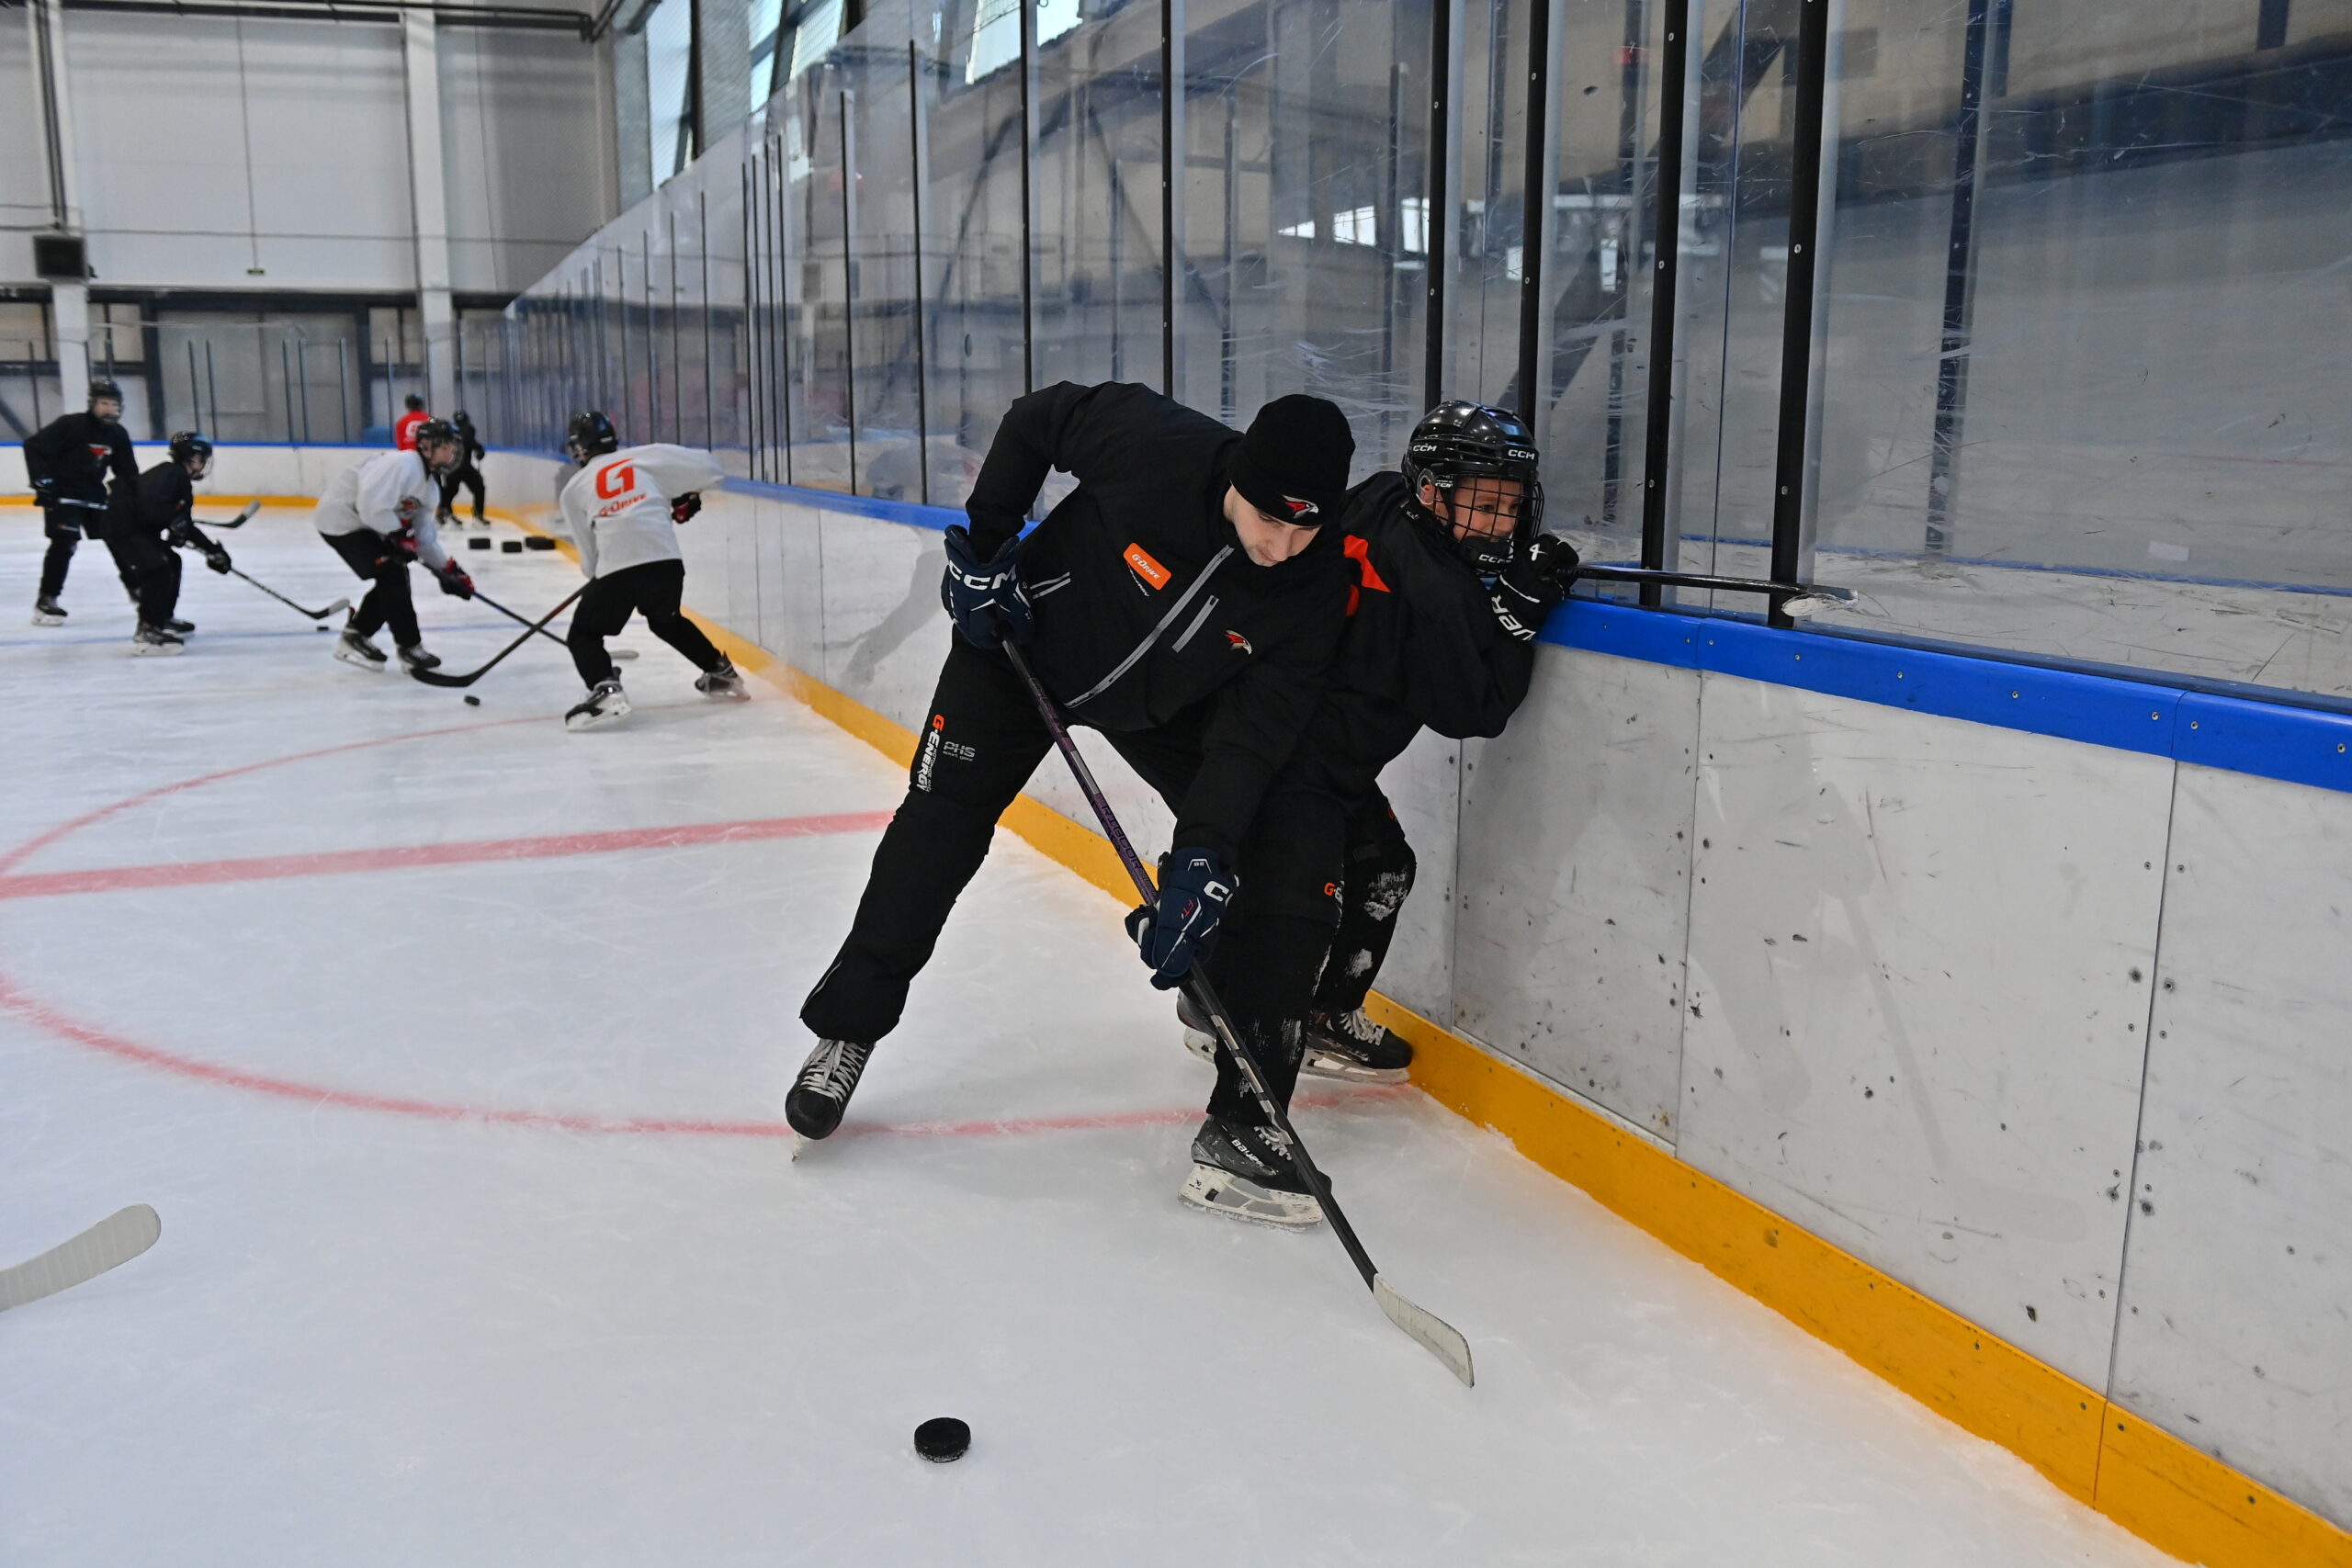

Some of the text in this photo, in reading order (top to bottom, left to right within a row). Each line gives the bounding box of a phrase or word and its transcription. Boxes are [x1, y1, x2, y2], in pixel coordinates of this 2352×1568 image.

[1413, 445, 1437, 453] CCM
[1508, 448, 1535, 460] CCM
[949, 559, 1017, 591] CCM
[916, 714, 945, 792] G-ENERGY
[1100, 803, 1143, 870] RIBCOR
